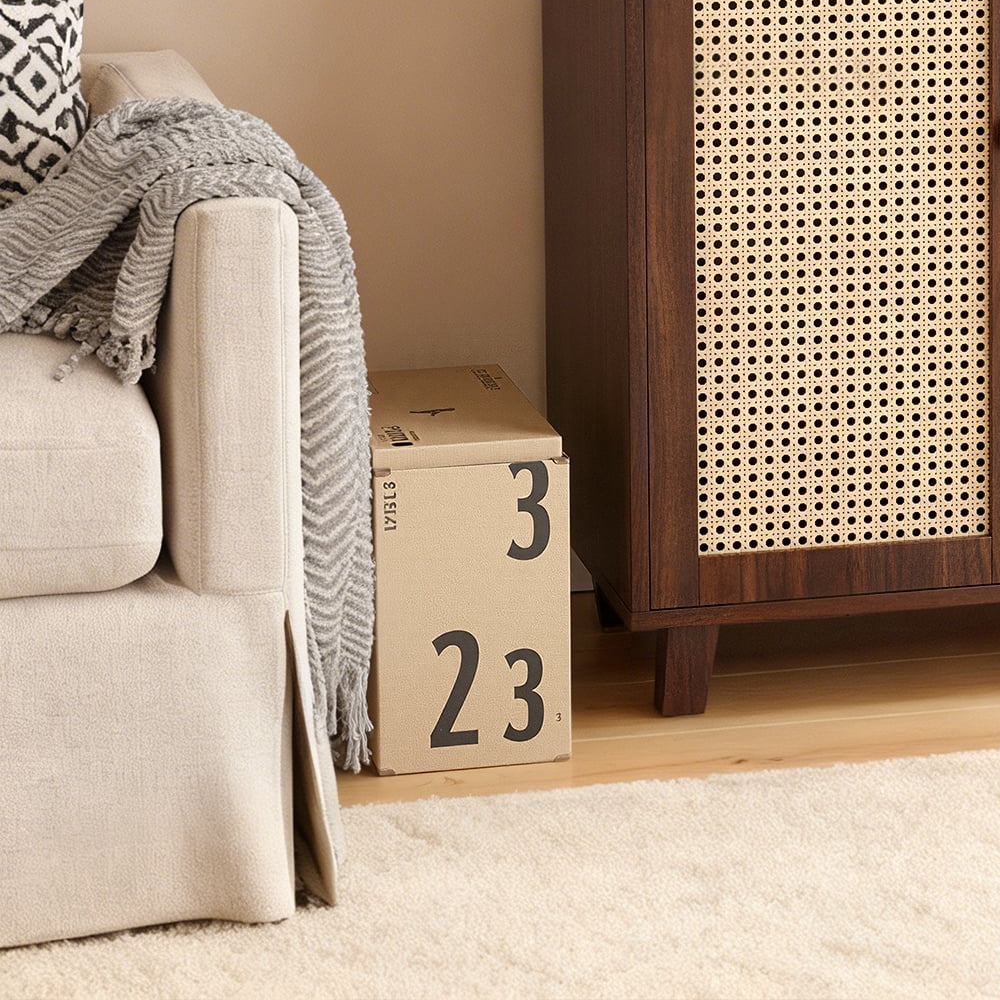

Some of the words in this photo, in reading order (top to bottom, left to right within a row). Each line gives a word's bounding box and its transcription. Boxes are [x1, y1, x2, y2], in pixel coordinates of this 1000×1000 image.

[507, 460, 551, 560] 3
[430, 629, 480, 748] 2
[503, 647, 545, 742] 3
[555, 712, 562, 722] 3
